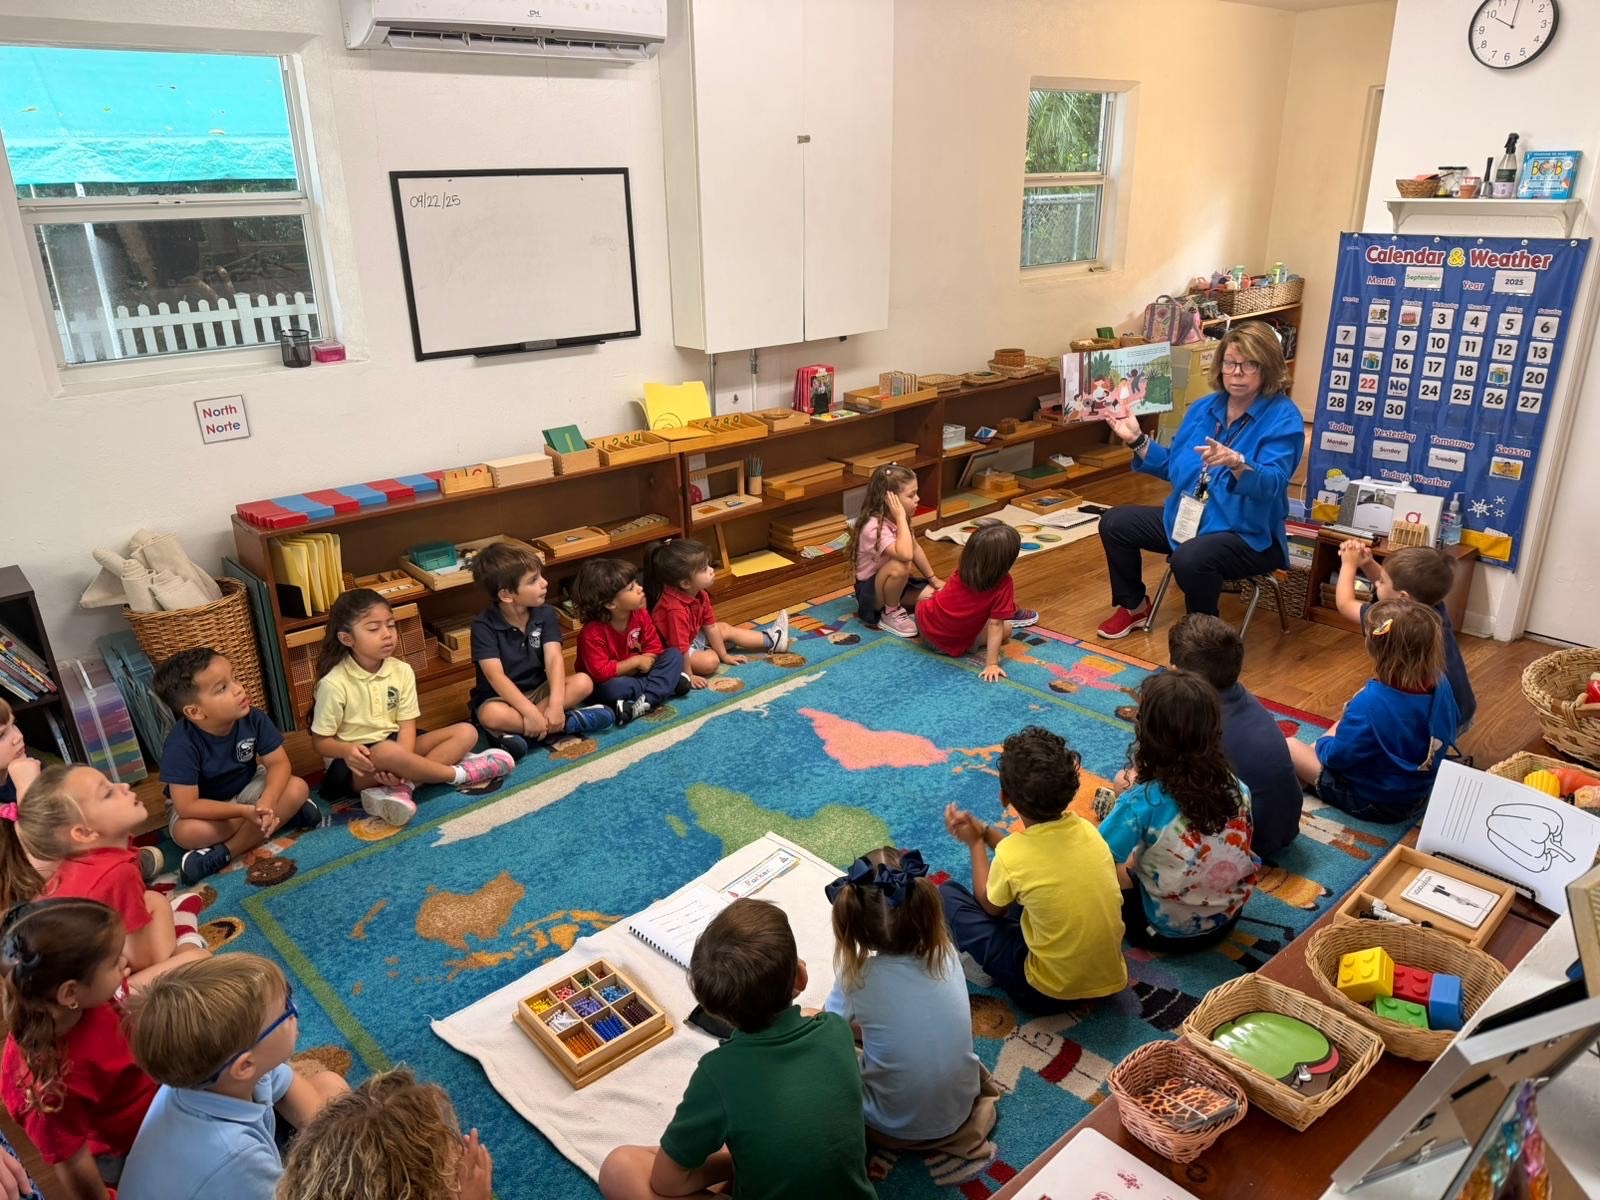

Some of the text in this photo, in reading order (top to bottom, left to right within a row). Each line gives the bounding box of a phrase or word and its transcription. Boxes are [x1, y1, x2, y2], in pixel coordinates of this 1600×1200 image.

[1486, 10, 1497, 19] 10
[1538, 4, 1545, 13] 2
[1540, 19, 1547, 28] 3
[1478, 26, 1485, 35] 9
[1480, 40, 1487, 48] 8
[1533, 35, 1539, 43] 4
[1491, 50, 1498, 59] 7
[1503, 52, 1510, 61] 6
[1519, 48, 1526, 56] 5
[409, 191, 461, 209] 09/22/25
[1366, 245, 1553, 269] Calendar & Weather
[1366, 275, 1396, 287] Month
[1463, 280, 1485, 291] Year
[1504, 278, 1524, 287] 2025
[1437, 313, 1550, 333] 3 4 5 6
[1342, 330, 1548, 359] 7 9 10 11 12 13
[1336, 353, 1545, 384] 14 16 17 18 20
[1333, 375, 1540, 409] 21 22 No 24 25 26 27
[202, 404, 237, 419] North
[1329, 396, 1404, 416] 28 29 30
[206, 421, 241, 435] Norte
[1328, 421, 1354, 434] Today
[1374, 427, 1417, 443] Yesterday
[1326, 438, 1349, 448] Monday
[1430, 434, 1475, 450] Tomorrow
[1379, 446, 1401, 455] Sunday
[1495, 444, 1532, 458] Season
[1434, 455, 1458, 465] Tuesday
[1380, 468, 1452, 488] Today's Weather
[1405, 511, 1421, 524] a
